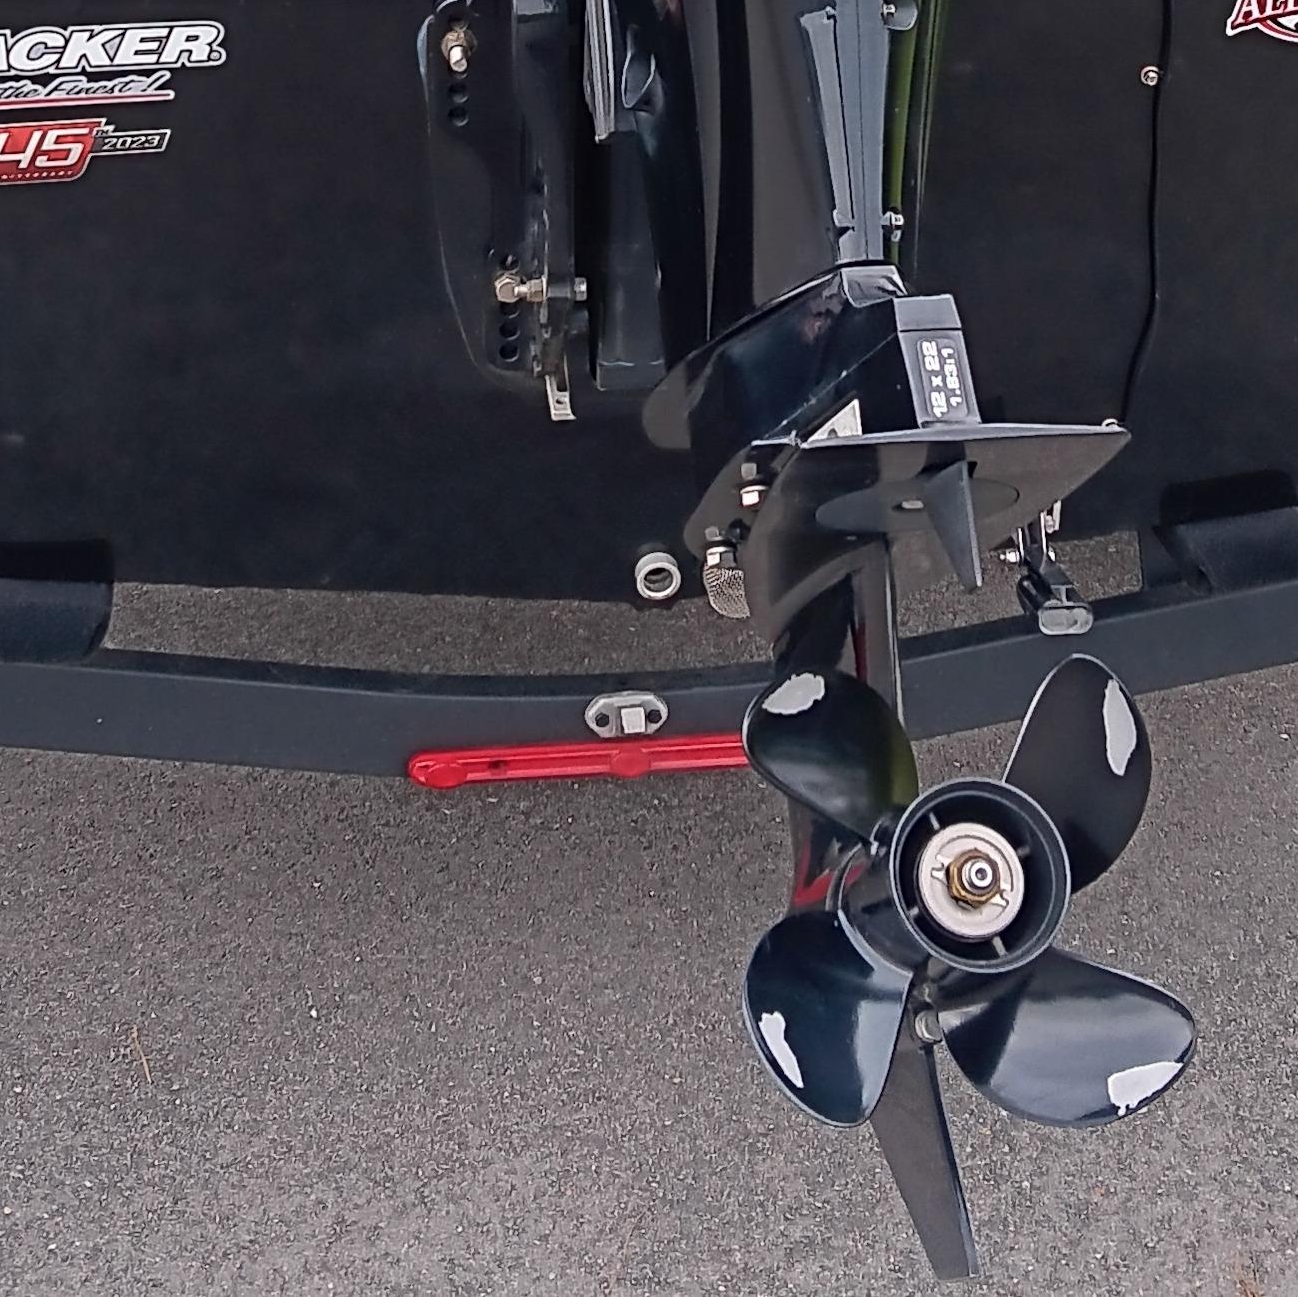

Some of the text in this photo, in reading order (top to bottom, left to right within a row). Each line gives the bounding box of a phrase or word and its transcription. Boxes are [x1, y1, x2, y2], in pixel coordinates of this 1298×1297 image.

[102, 134, 160, 152] 2023
[922, 341, 941, 371] 22
[930, 391, 948, 418] 12
